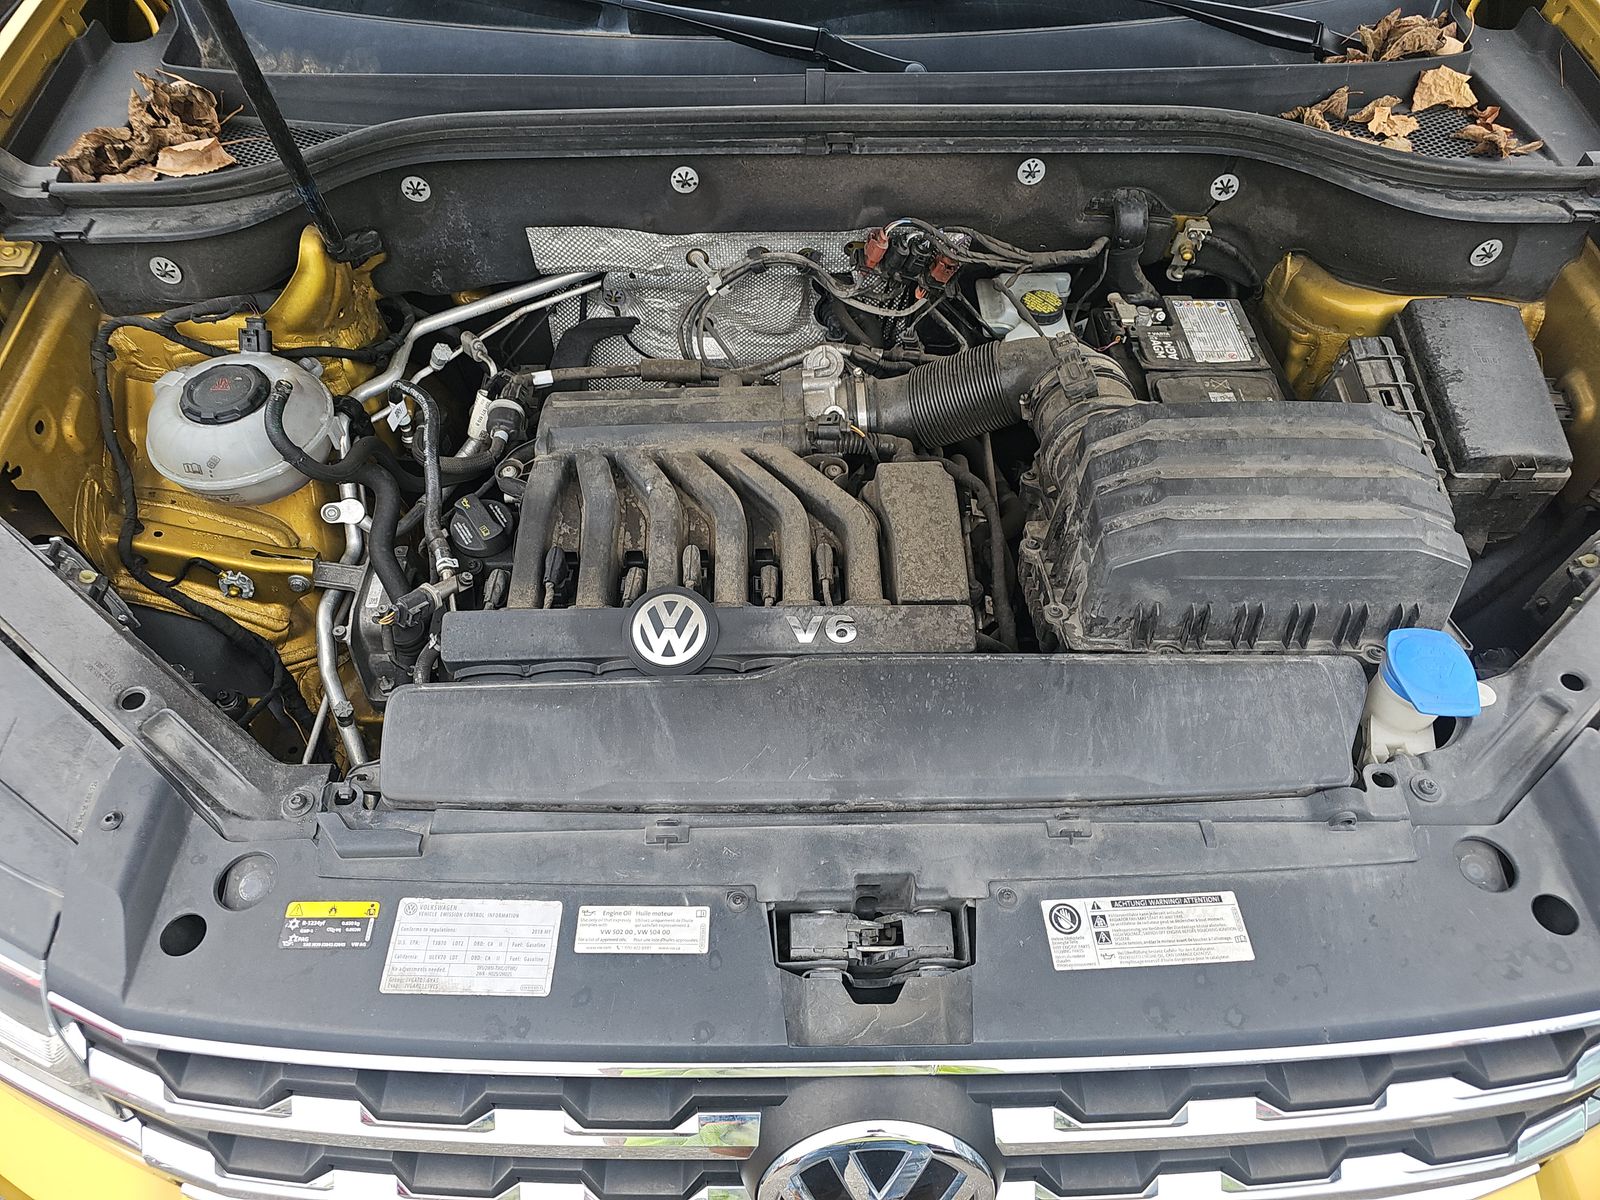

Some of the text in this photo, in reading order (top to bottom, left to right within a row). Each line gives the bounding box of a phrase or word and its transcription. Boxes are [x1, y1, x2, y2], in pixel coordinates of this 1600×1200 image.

[1162, 341, 1180, 360] AGM
[632, 594, 706, 665] VW
[786, 615, 858, 644] V6
[1148, 898, 1182, 906] WARNING!
[1183, 896, 1220, 904] ATTENTION!
[758, 1120, 996, 1200] V
